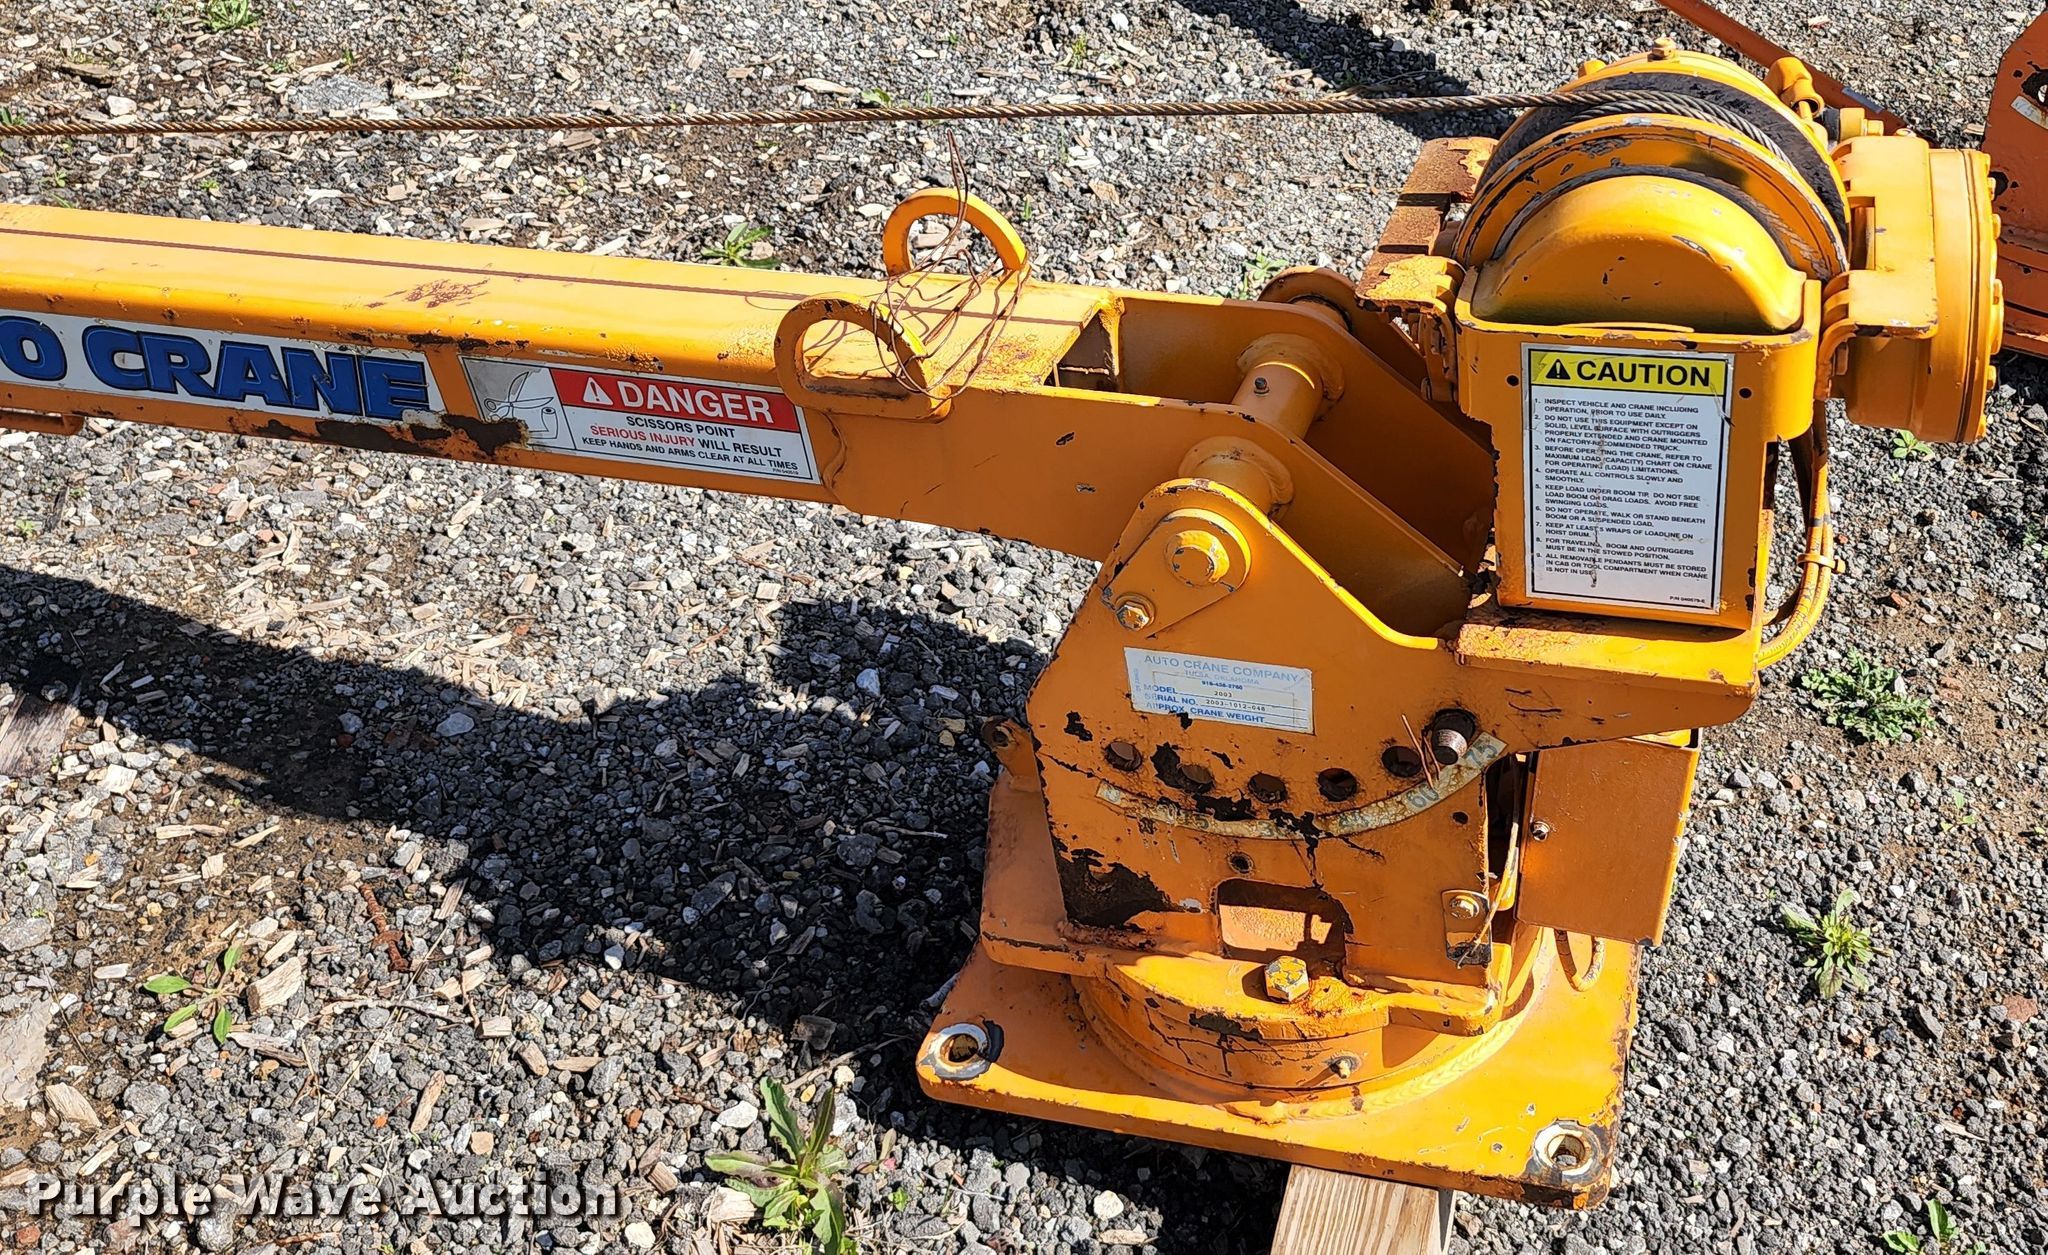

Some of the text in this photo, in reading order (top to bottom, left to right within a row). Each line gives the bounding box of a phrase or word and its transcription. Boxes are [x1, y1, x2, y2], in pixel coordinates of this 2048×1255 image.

[82, 324, 430, 421] CRANE
[1576, 359, 1710, 388] CAUTION
[615, 380, 774, 424] DANGER
[1577, 400, 1608, 408] VEHICLE
[1656, 405, 1698, 413] INCLUDING
[1590, 408, 1613, 416] PRIOR
[625, 415, 736, 438] SCISSORS POINT
[1609, 418, 1653, 427] EQUIPMENT
[1655, 421, 1684, 429] EXCEPT
[1544, 429, 1582, 437] PROPERLY
[1584, 432, 1622, 440] EXTENDED
[1670, 437, 1707, 446] MOUNTED
[1593, 425, 1628, 433] SURFACE
[1650, 429, 1700, 438] OUTRIGGERS
[589, 424, 783, 458] SERIOUS INJURY WILL RESULT
[581, 436, 798, 470] KEEP HANDS AND ARMS CLEAR AT ALL TIMES
[1575, 447, 1617, 456] OPERTING
[1635, 451, 1663, 459] CRANE,
[1665, 453, 1689, 461] REFER
[1544, 452, 1579, 460] MAXIMUM
[1686, 462, 1712, 470] CRANE
[1544, 467, 1578, 475] OPERATE
[1594, 471, 1634, 479] CONTROLS
[1636, 474, 1665, 482] SLOWLY
[1631, 465, 1679, 474] LIMITATIONS.
[1544, 498, 1581, 506] SWINGING
[1574, 508, 1608, 516] OPERATE,
[1671, 516, 1705, 524] BENEATH
[1587, 516, 1631, 525] SUSPENDED
[1605, 526, 1631, 534] WRAPS
[1644, 530, 1680, 538] LOADLINE
[1602, 548, 1632, 556] STOWED
[1634, 551, 1670, 559] POSITION.
[1646, 546, 1694, 554] OUTRIGGERS
[1603, 564, 1657, 574] COMPARTMENT
[1604, 558, 1641, 566] PENDANTS
[1143, 654, 1299, 682] AUTO CRANE COMPANY
[1143, 683, 1232, 698] MODEL 2003
[1144, 692, 1178, 703] SERIAL
[1180, 697, 1198, 705] NO.
[1190, 707, 1264, 723] CRANE WEIGHT
